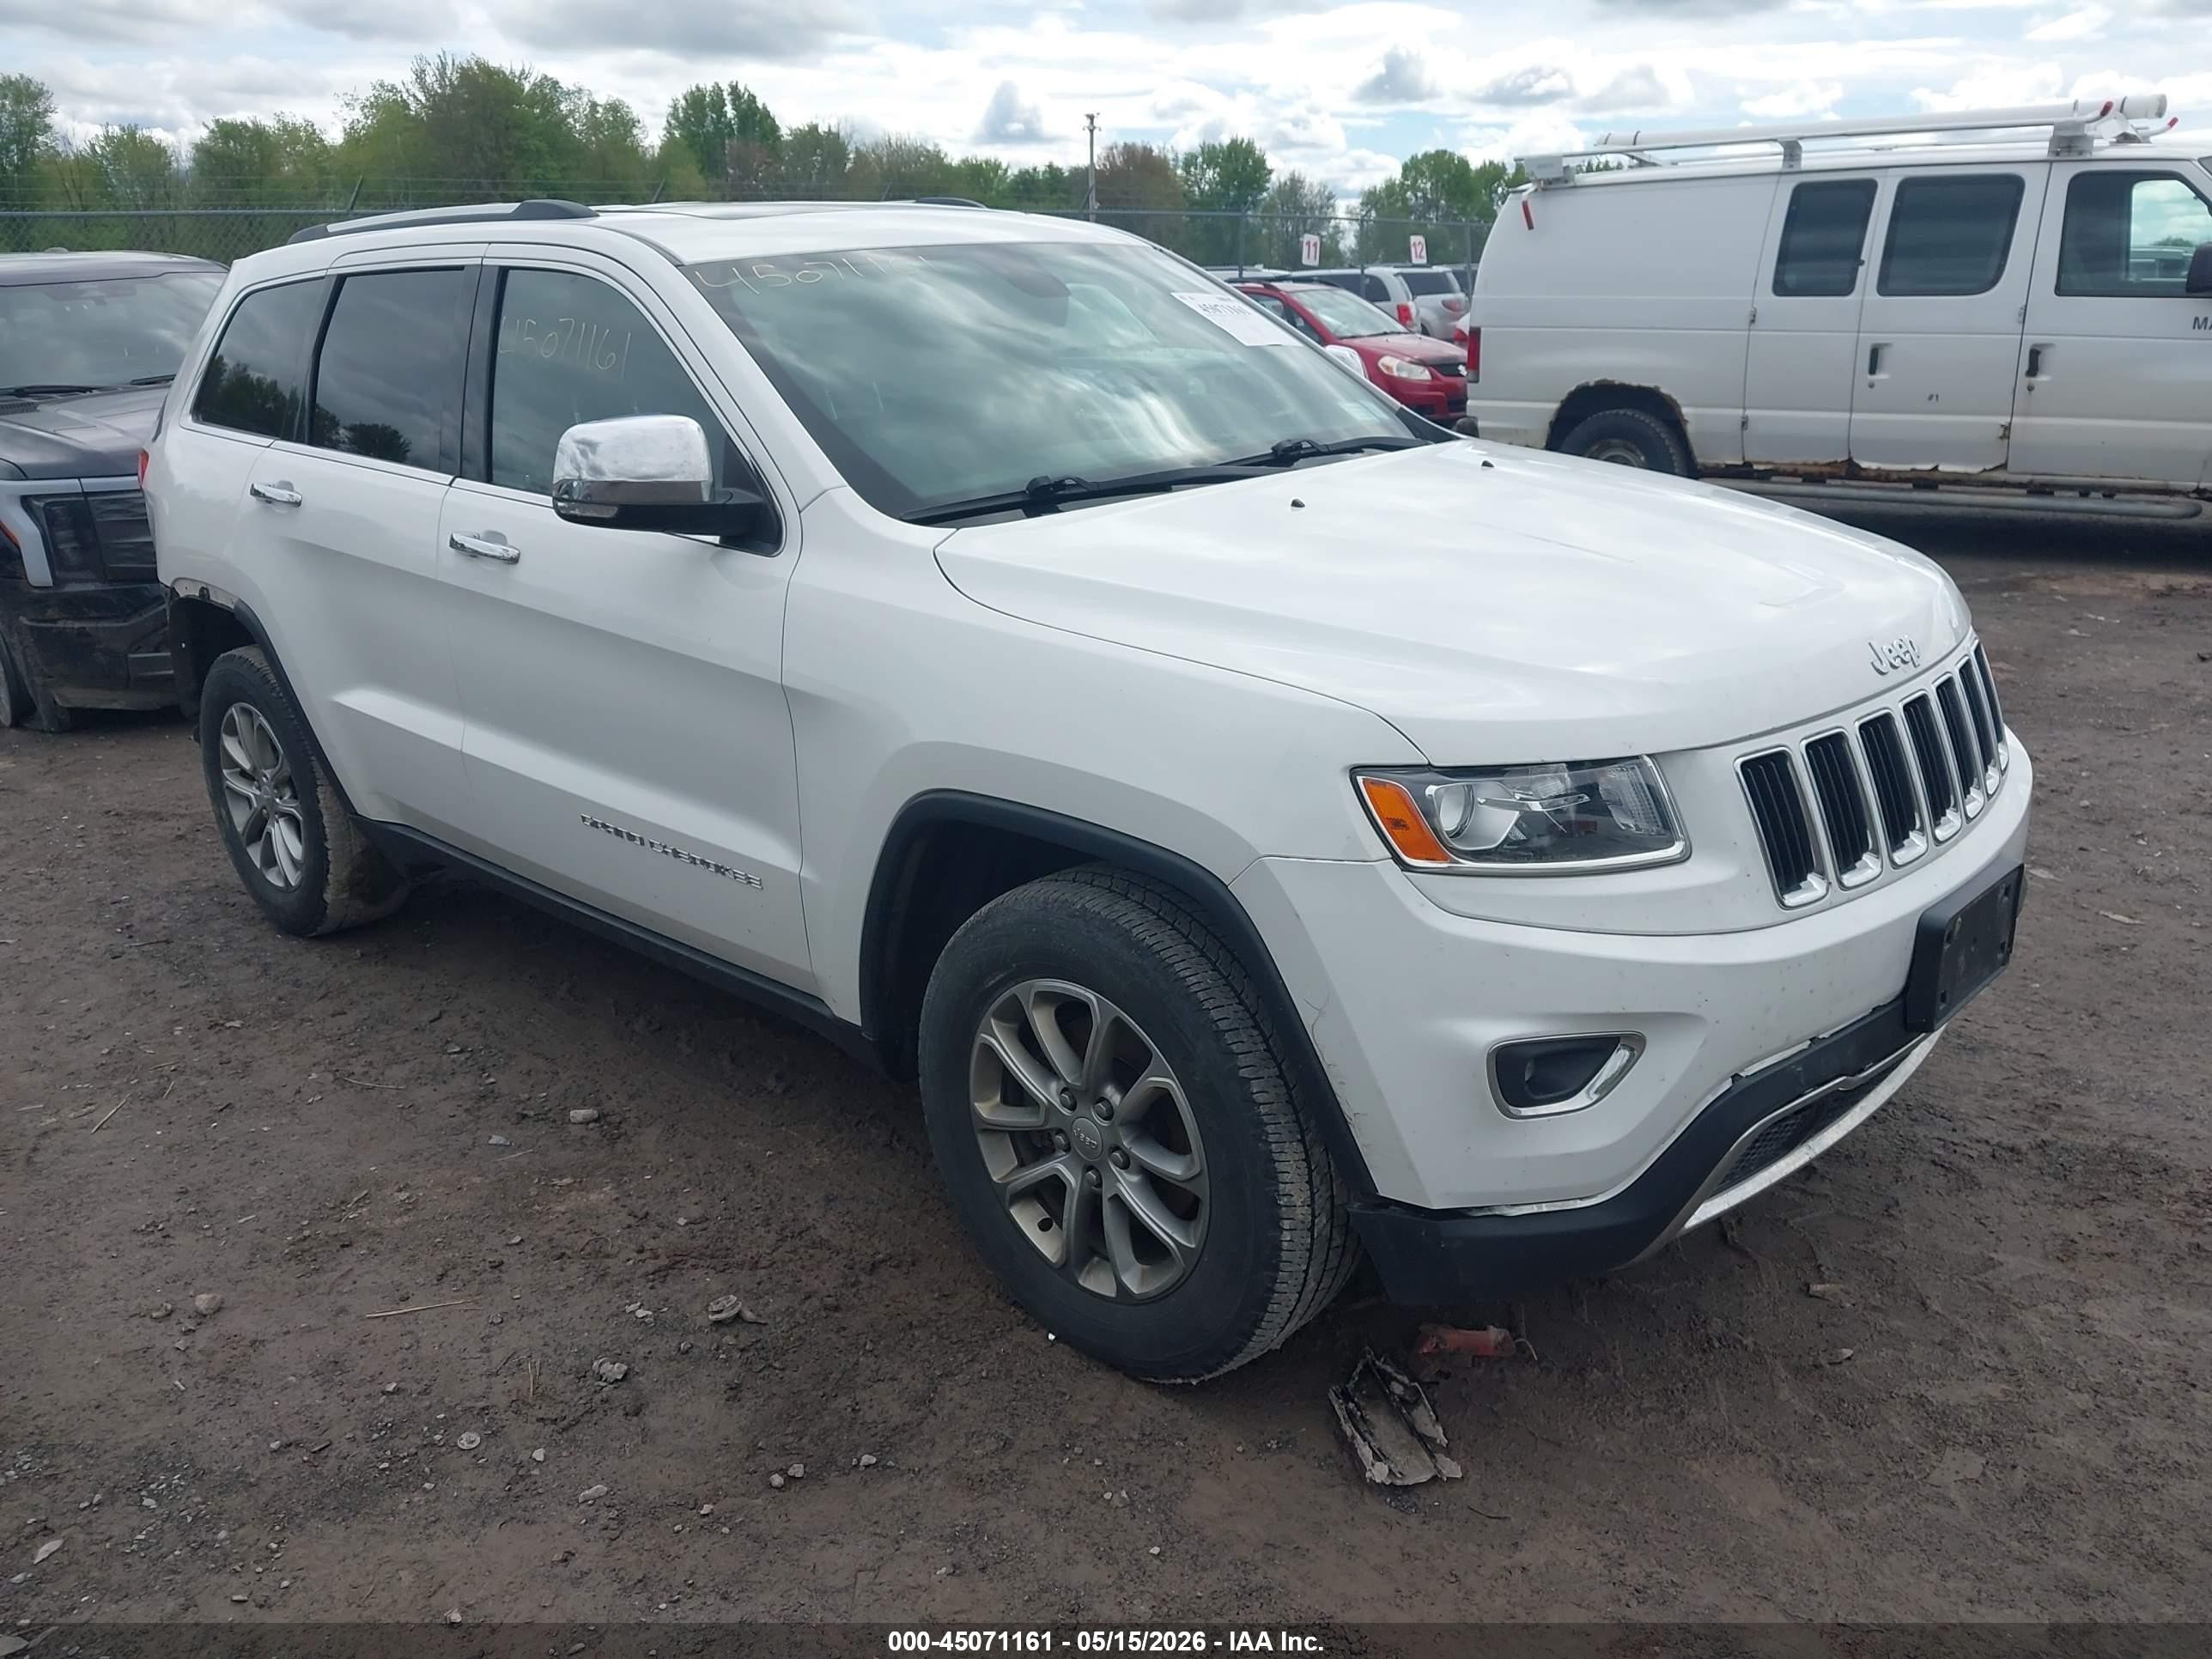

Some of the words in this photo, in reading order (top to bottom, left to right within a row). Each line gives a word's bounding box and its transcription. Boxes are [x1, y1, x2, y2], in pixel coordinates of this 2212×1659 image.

[1305, 240, 1319, 262] 11
[1411, 240, 1425, 259] 12
[2192, 316, 2212, 331] M
[1868, 634, 1921, 677] Jeep
[580, 813, 646, 846] GRAND
[648, 838, 763, 890] CHEROKEE
